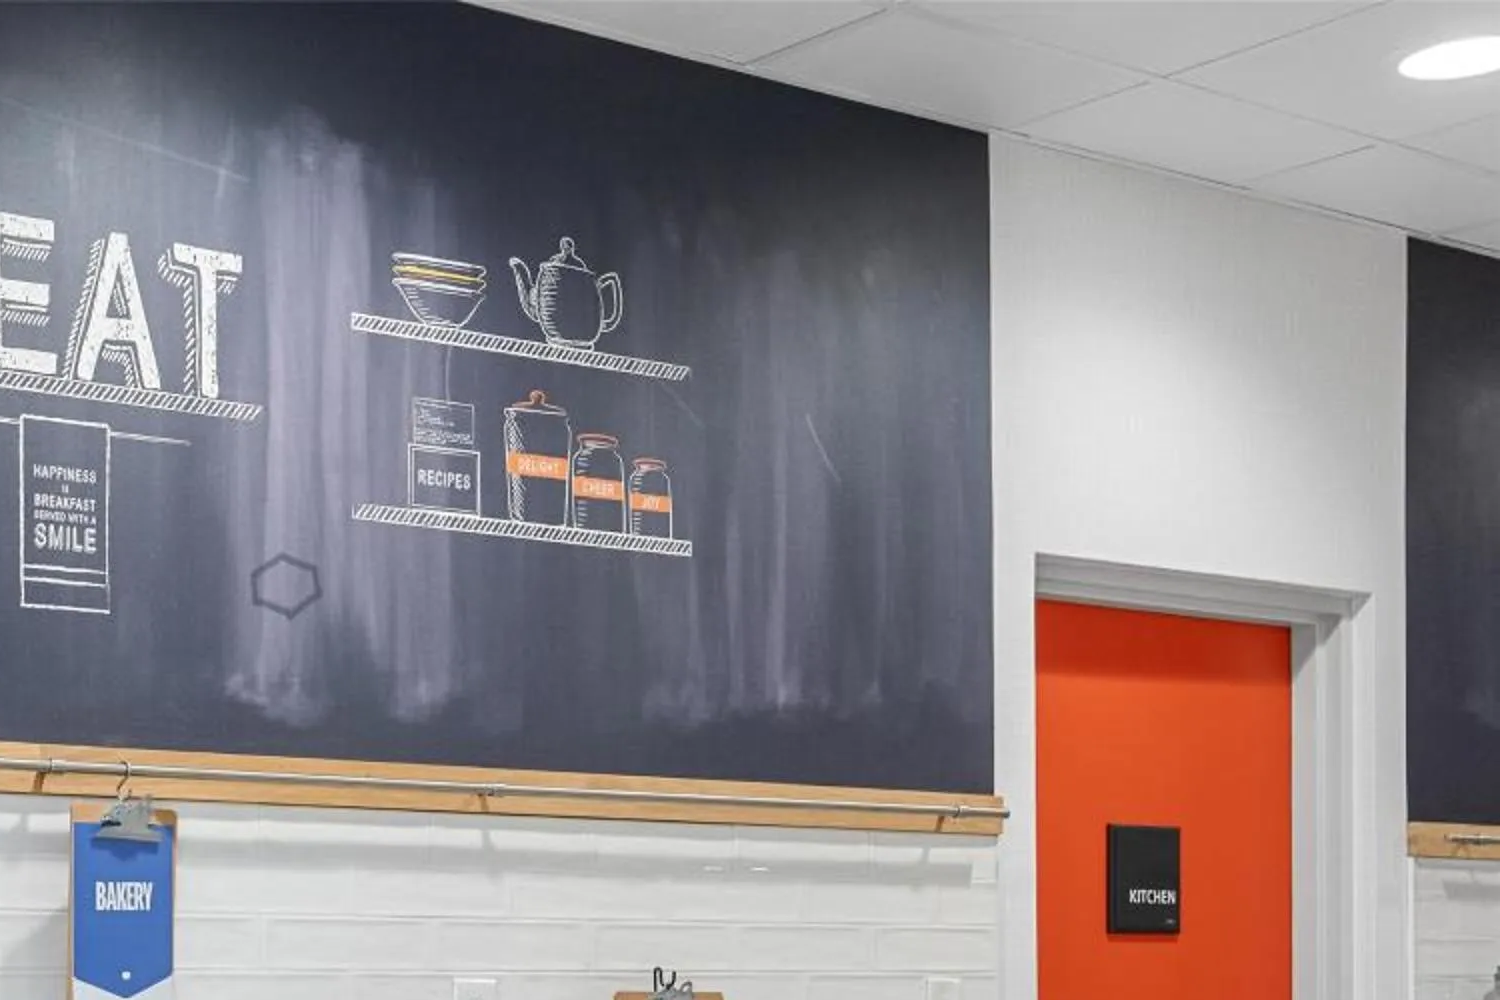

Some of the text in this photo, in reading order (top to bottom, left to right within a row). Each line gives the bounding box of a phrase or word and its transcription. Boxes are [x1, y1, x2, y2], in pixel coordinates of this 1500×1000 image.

[33, 463, 97, 484] HAPPINESS
[417, 468, 471, 490] RECIPES
[33, 493, 97, 513] BREAKFAST
[33, 522, 97, 554] SMILE
[95, 880, 153, 912] BAKERY
[1129, 888, 1176, 904] KITCHEN
